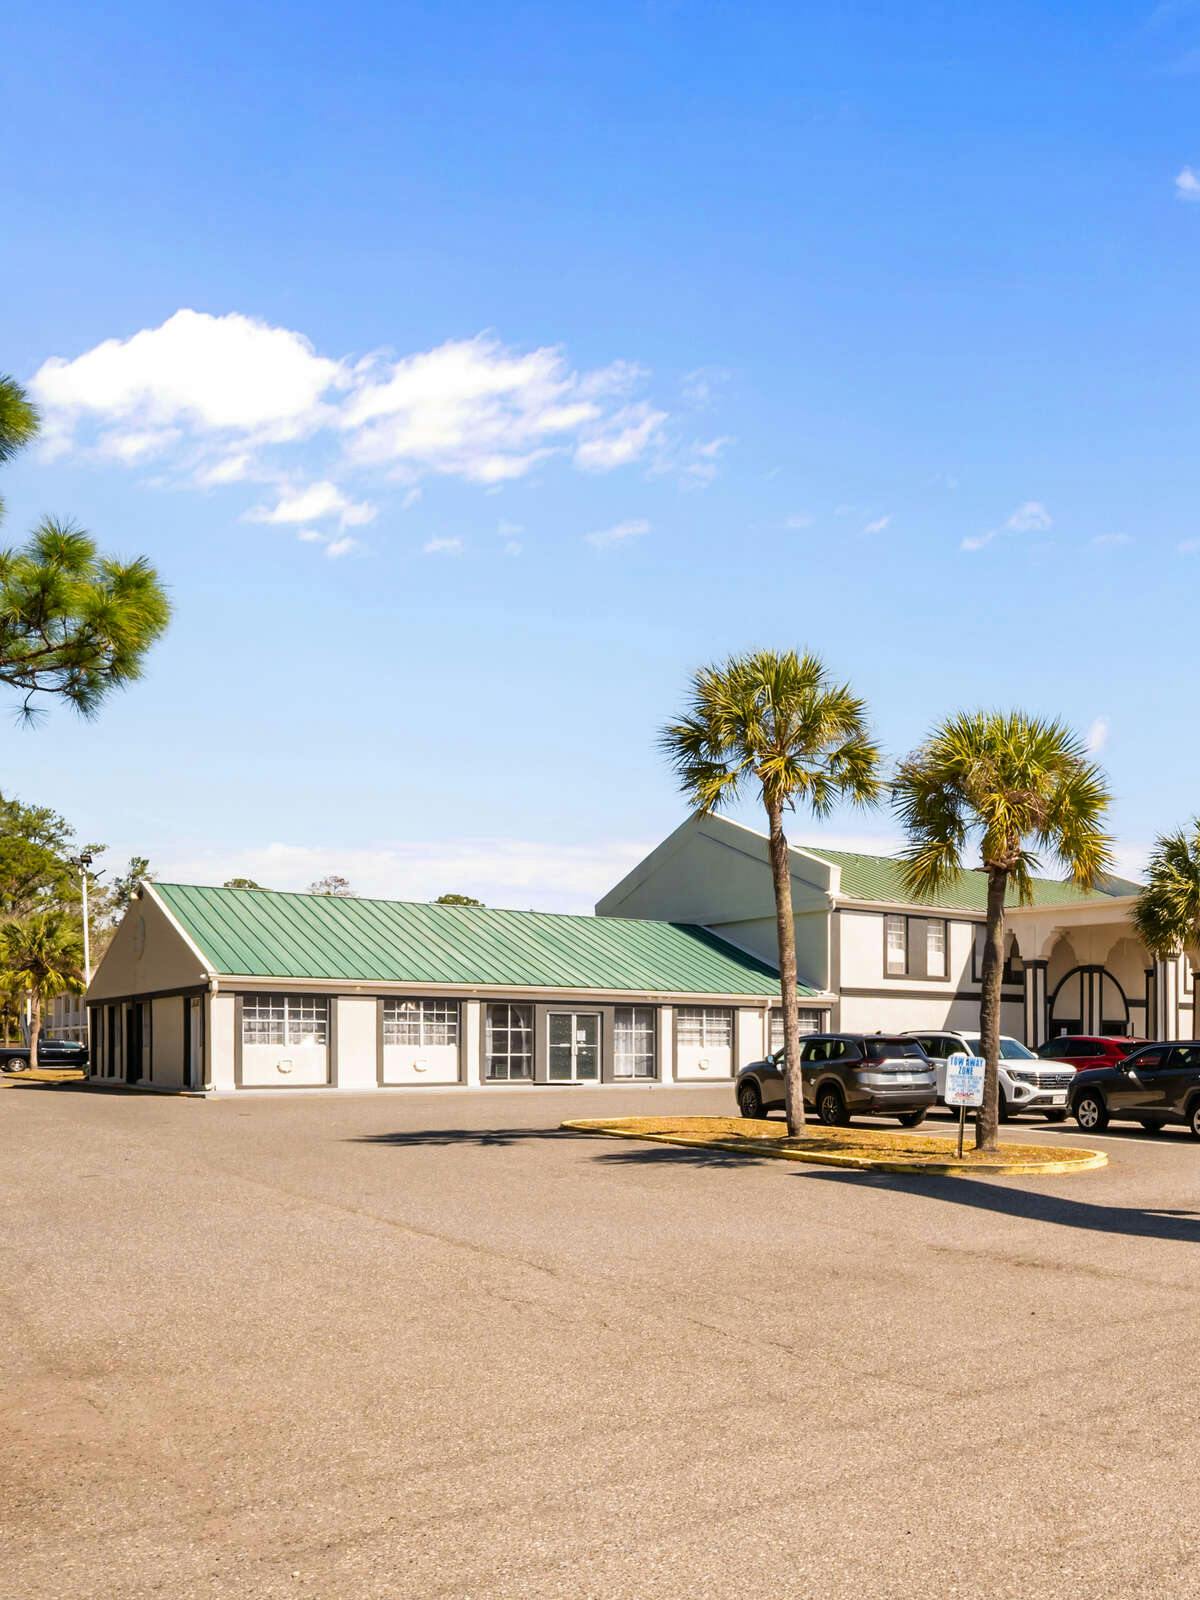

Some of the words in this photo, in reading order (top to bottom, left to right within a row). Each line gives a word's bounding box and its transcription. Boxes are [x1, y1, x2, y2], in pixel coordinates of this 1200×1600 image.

[950, 1056, 965, 1067] TOW
[966, 1057, 983, 1067] AWAY
[958, 1066, 974, 1075] ZONE
